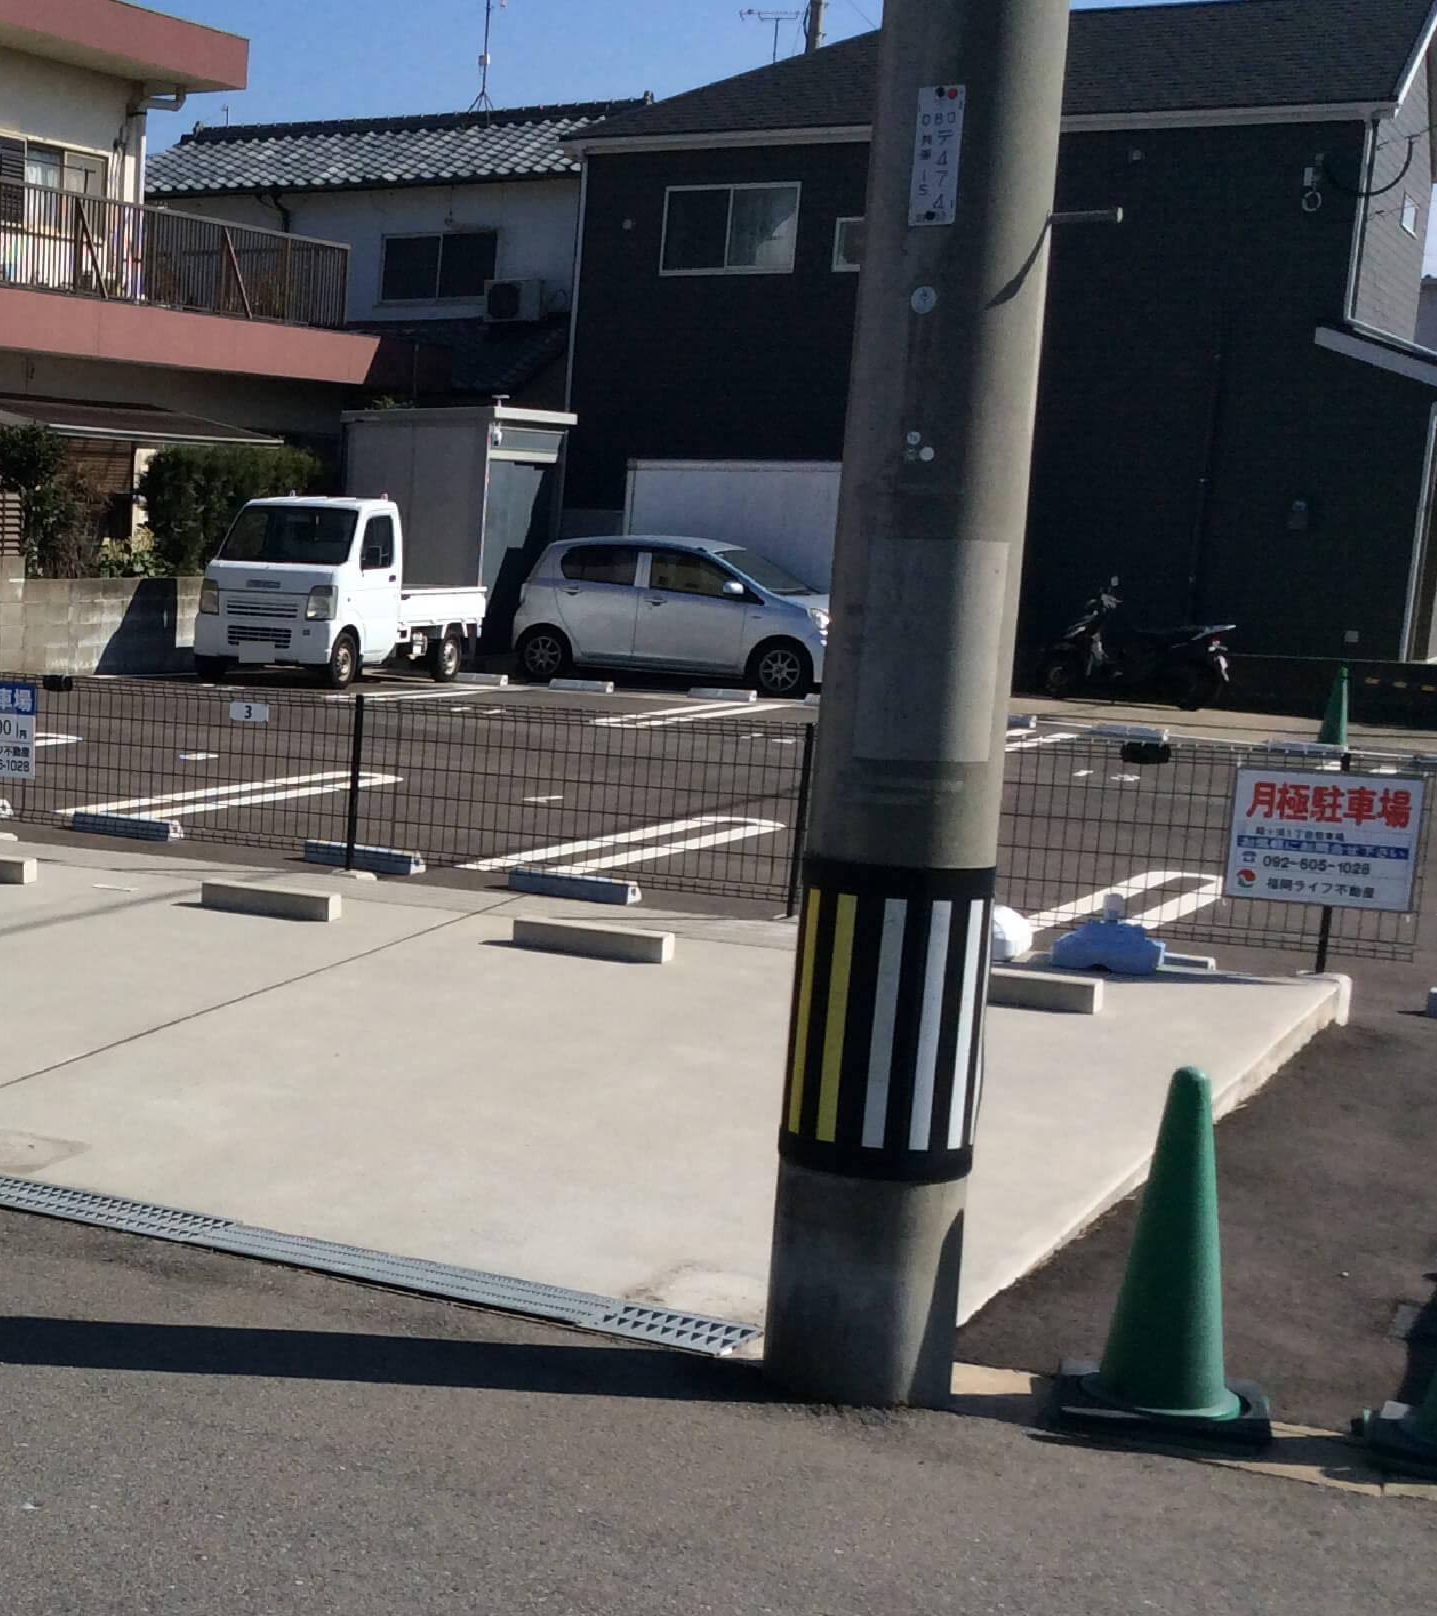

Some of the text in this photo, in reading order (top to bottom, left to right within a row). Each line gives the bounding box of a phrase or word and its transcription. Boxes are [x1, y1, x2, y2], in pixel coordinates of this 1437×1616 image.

[244, 705, 253, 719] 3
[1246, 781, 1413, 828] 月極駐車場
[1262, 855, 1370, 876] 092-605-1028
[1267, 877, 1375, 899] 福岡ライフ不動産
